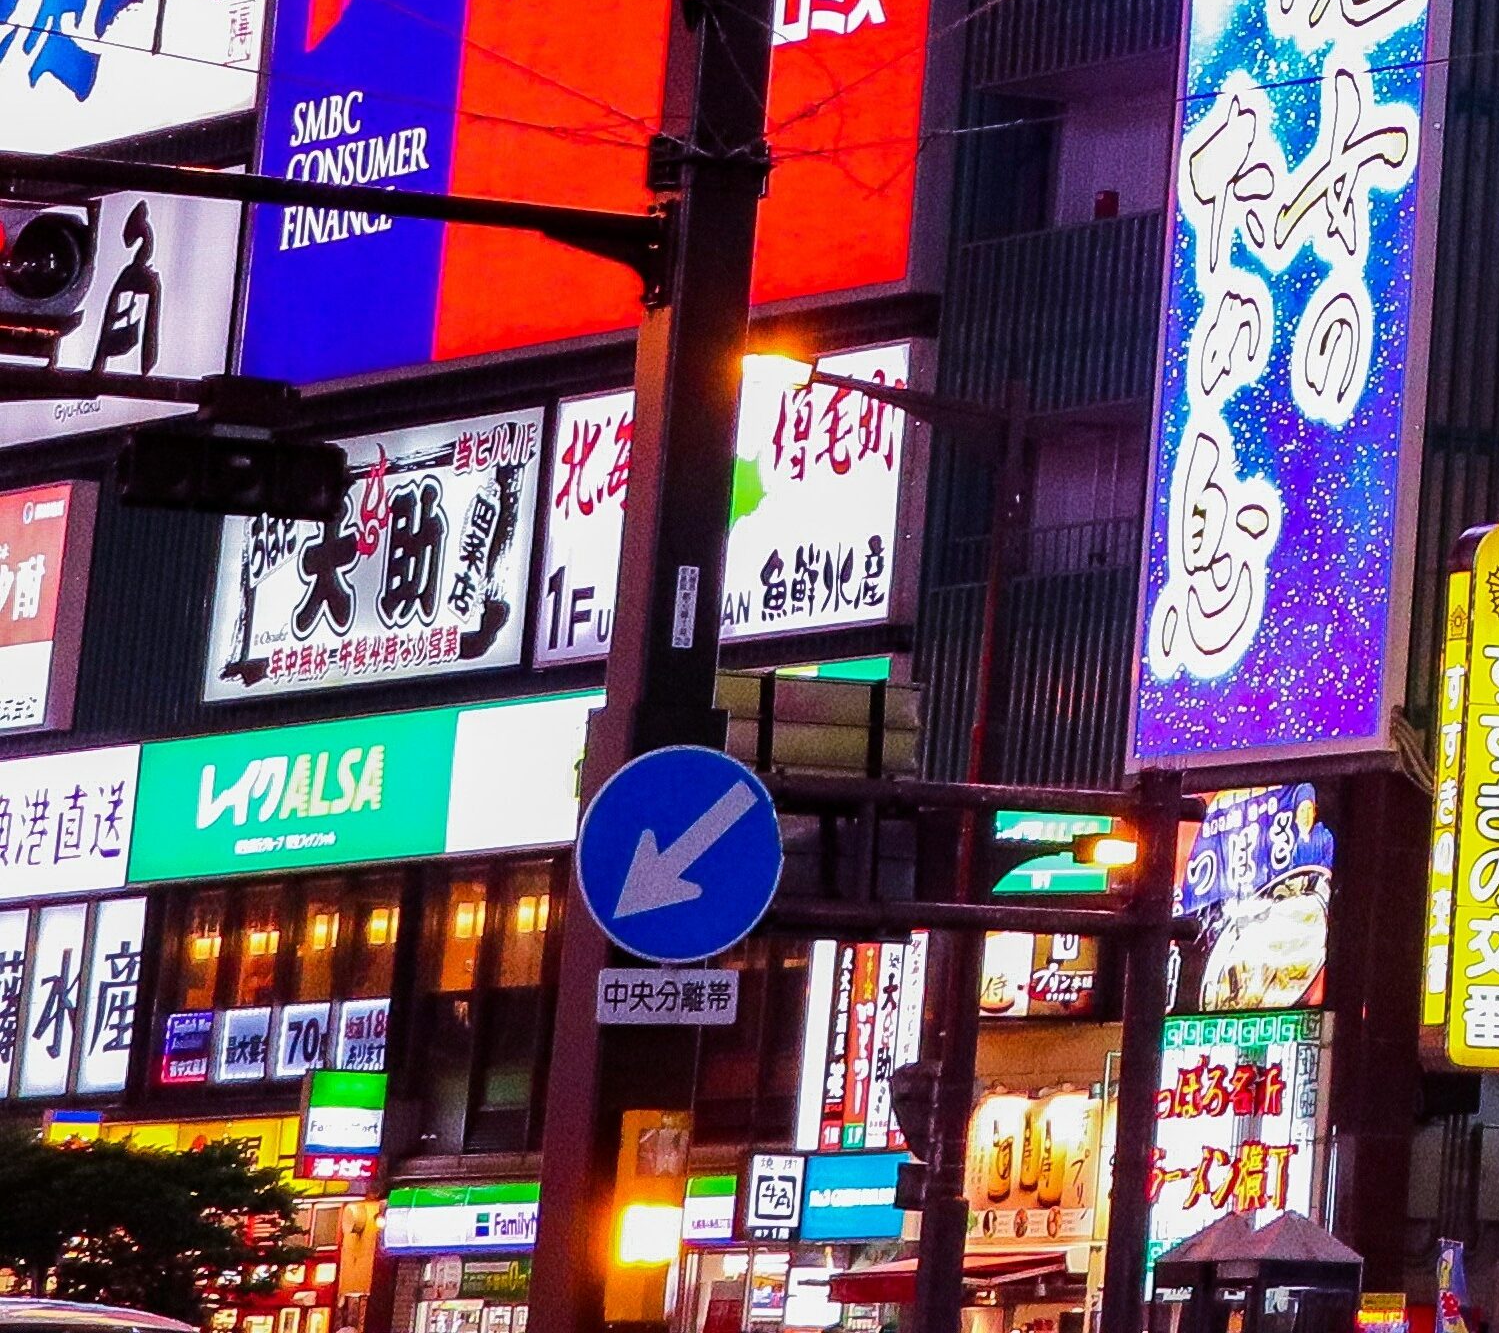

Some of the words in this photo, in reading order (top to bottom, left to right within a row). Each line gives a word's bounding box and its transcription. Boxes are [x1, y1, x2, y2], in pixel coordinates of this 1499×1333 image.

[290, 90, 364, 147] SMBC
[285, 127, 429, 184] CONSUMER
[760, 534, 886, 622] 魚鮮水産
[547, 565, 596, 651] 1F
[603, 979, 732, 1013] 中央分離帯
